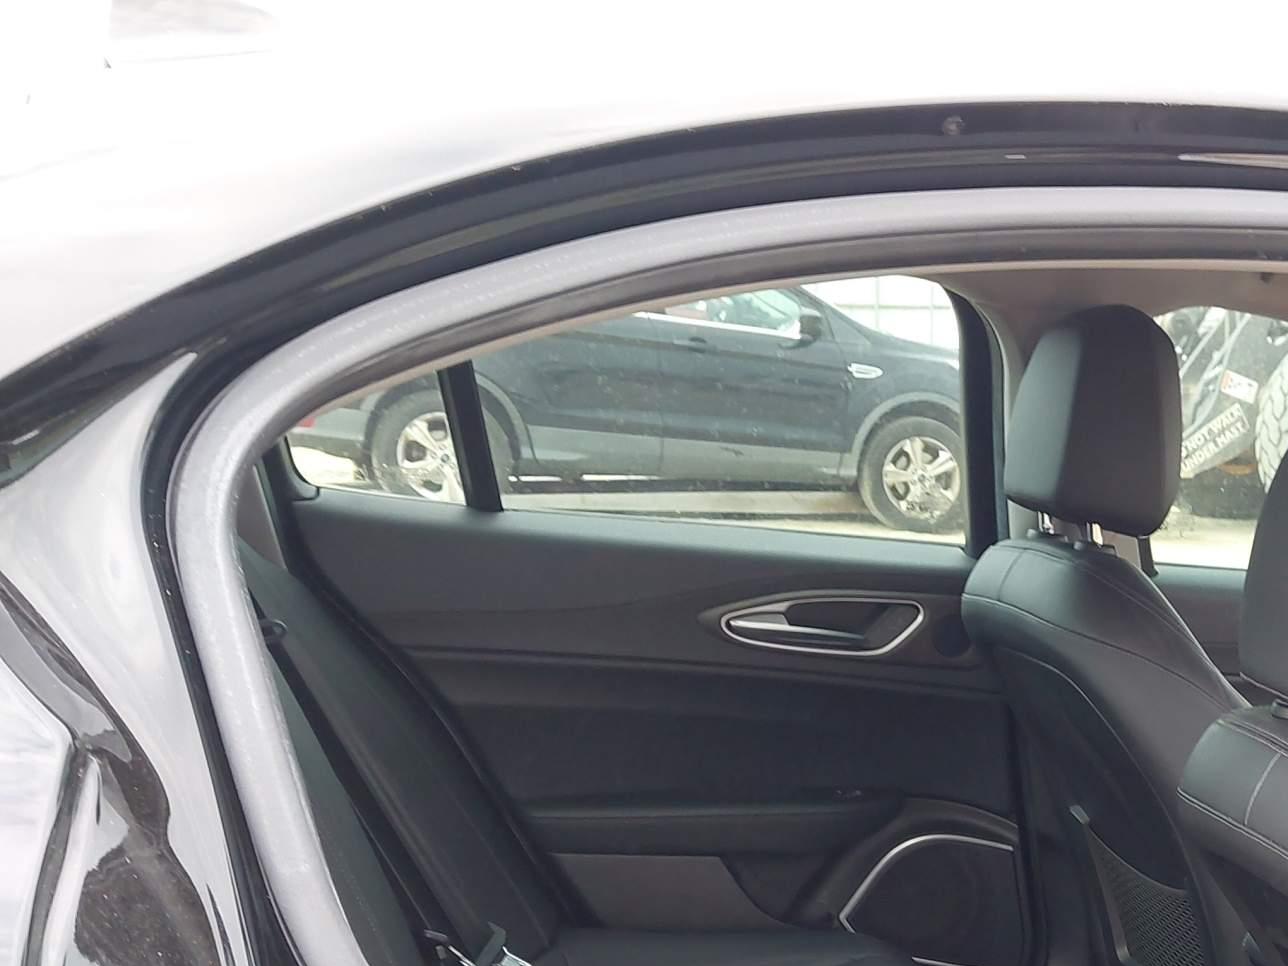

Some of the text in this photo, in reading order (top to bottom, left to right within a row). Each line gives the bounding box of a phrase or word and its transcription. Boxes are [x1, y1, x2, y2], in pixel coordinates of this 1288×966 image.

[1180, 441, 1219, 471] UNDER
[1215, 419, 1246, 448] MAST
[1183, 424, 1210, 451] NOT
[1208, 403, 1242, 433] WALK
